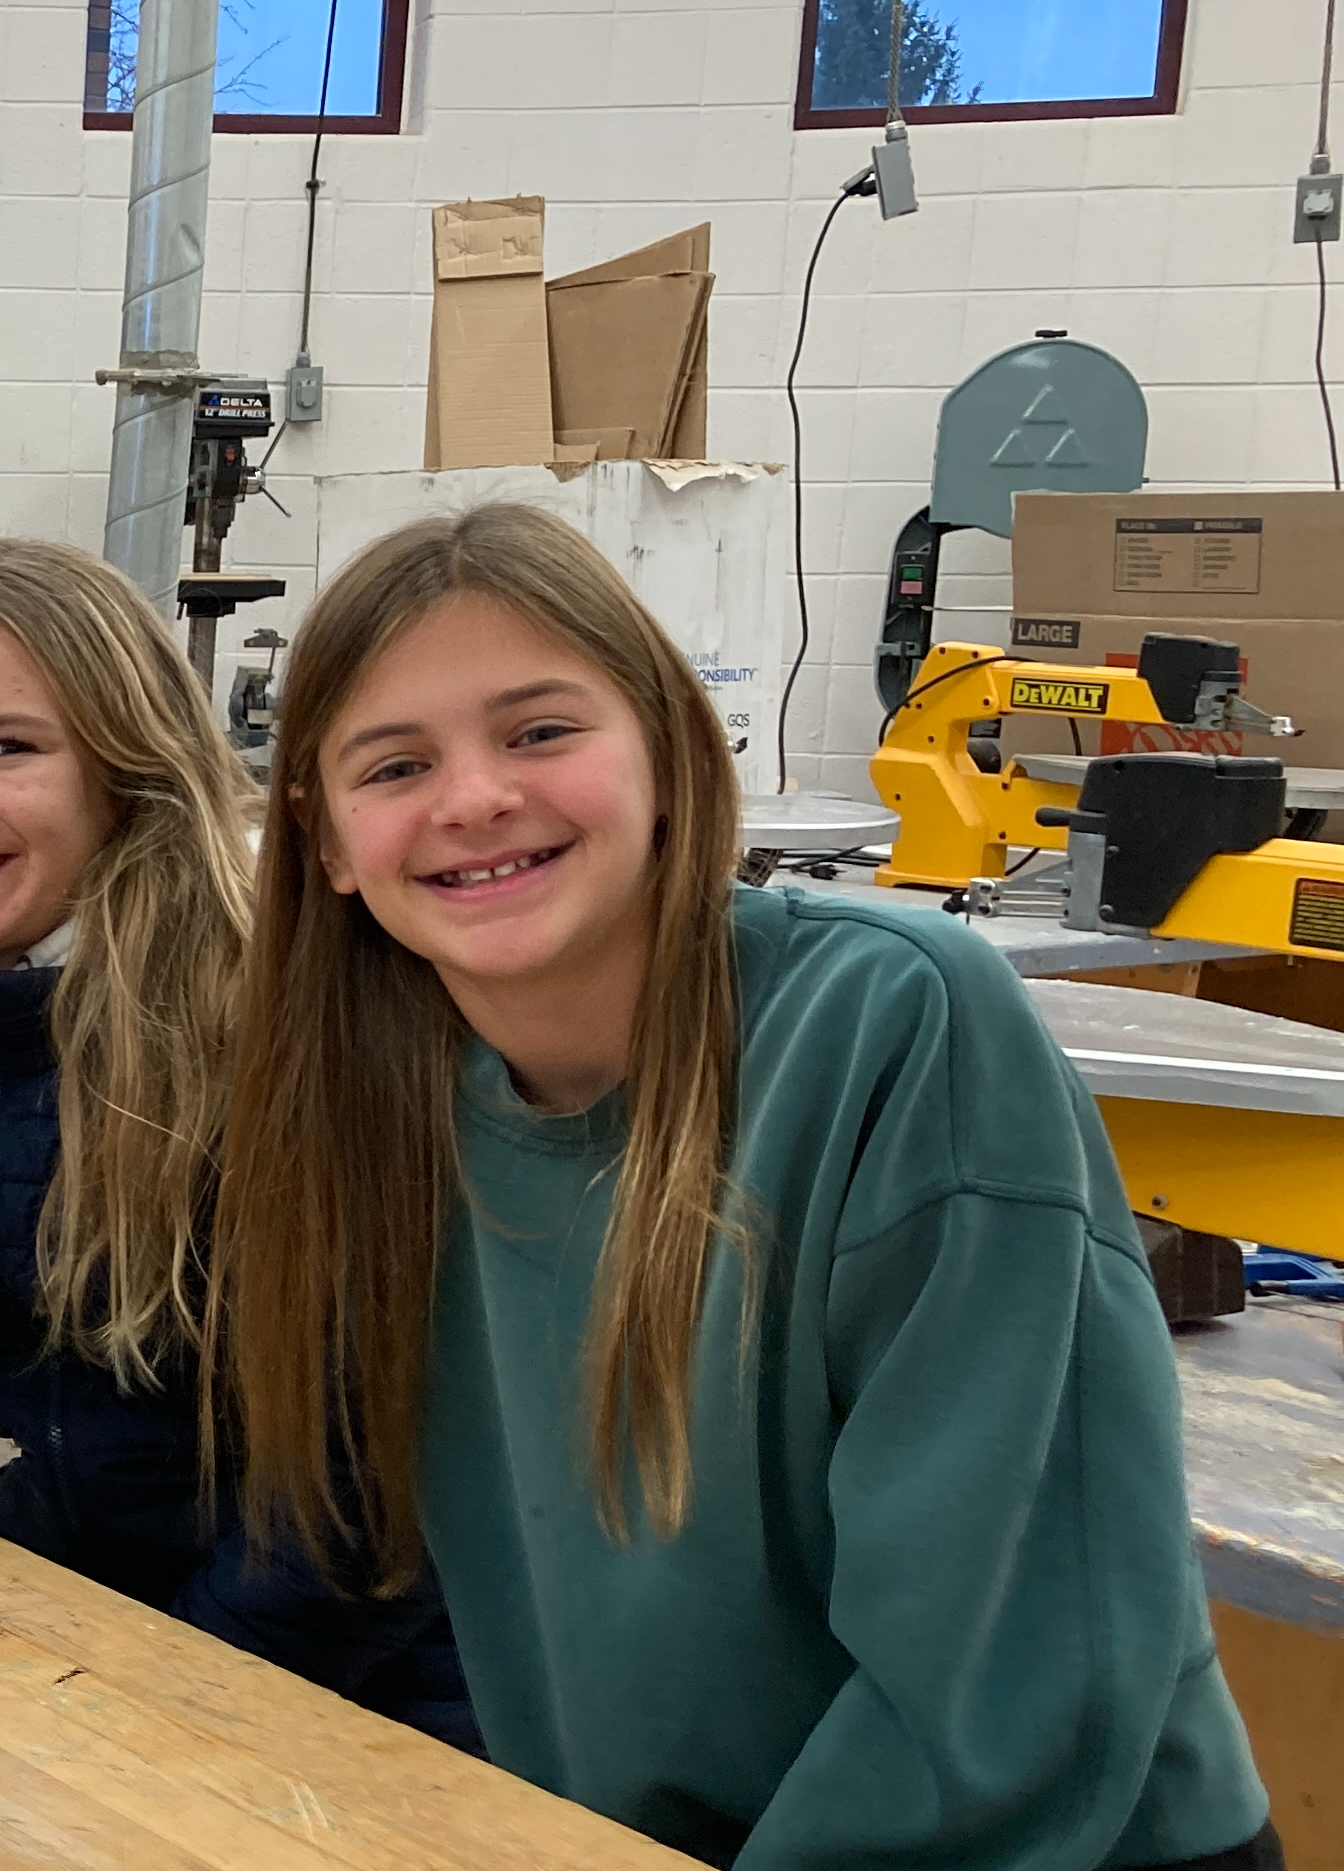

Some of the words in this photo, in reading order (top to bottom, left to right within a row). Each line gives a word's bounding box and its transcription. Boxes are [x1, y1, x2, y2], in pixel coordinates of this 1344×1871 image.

[220, 397, 263, 407] DELTA
[218, 409, 241, 418] DRILL
[241, 409, 266, 418] PRESS
[1017, 623, 1073, 643] LARGE
[727, 713, 750, 728] GQS
